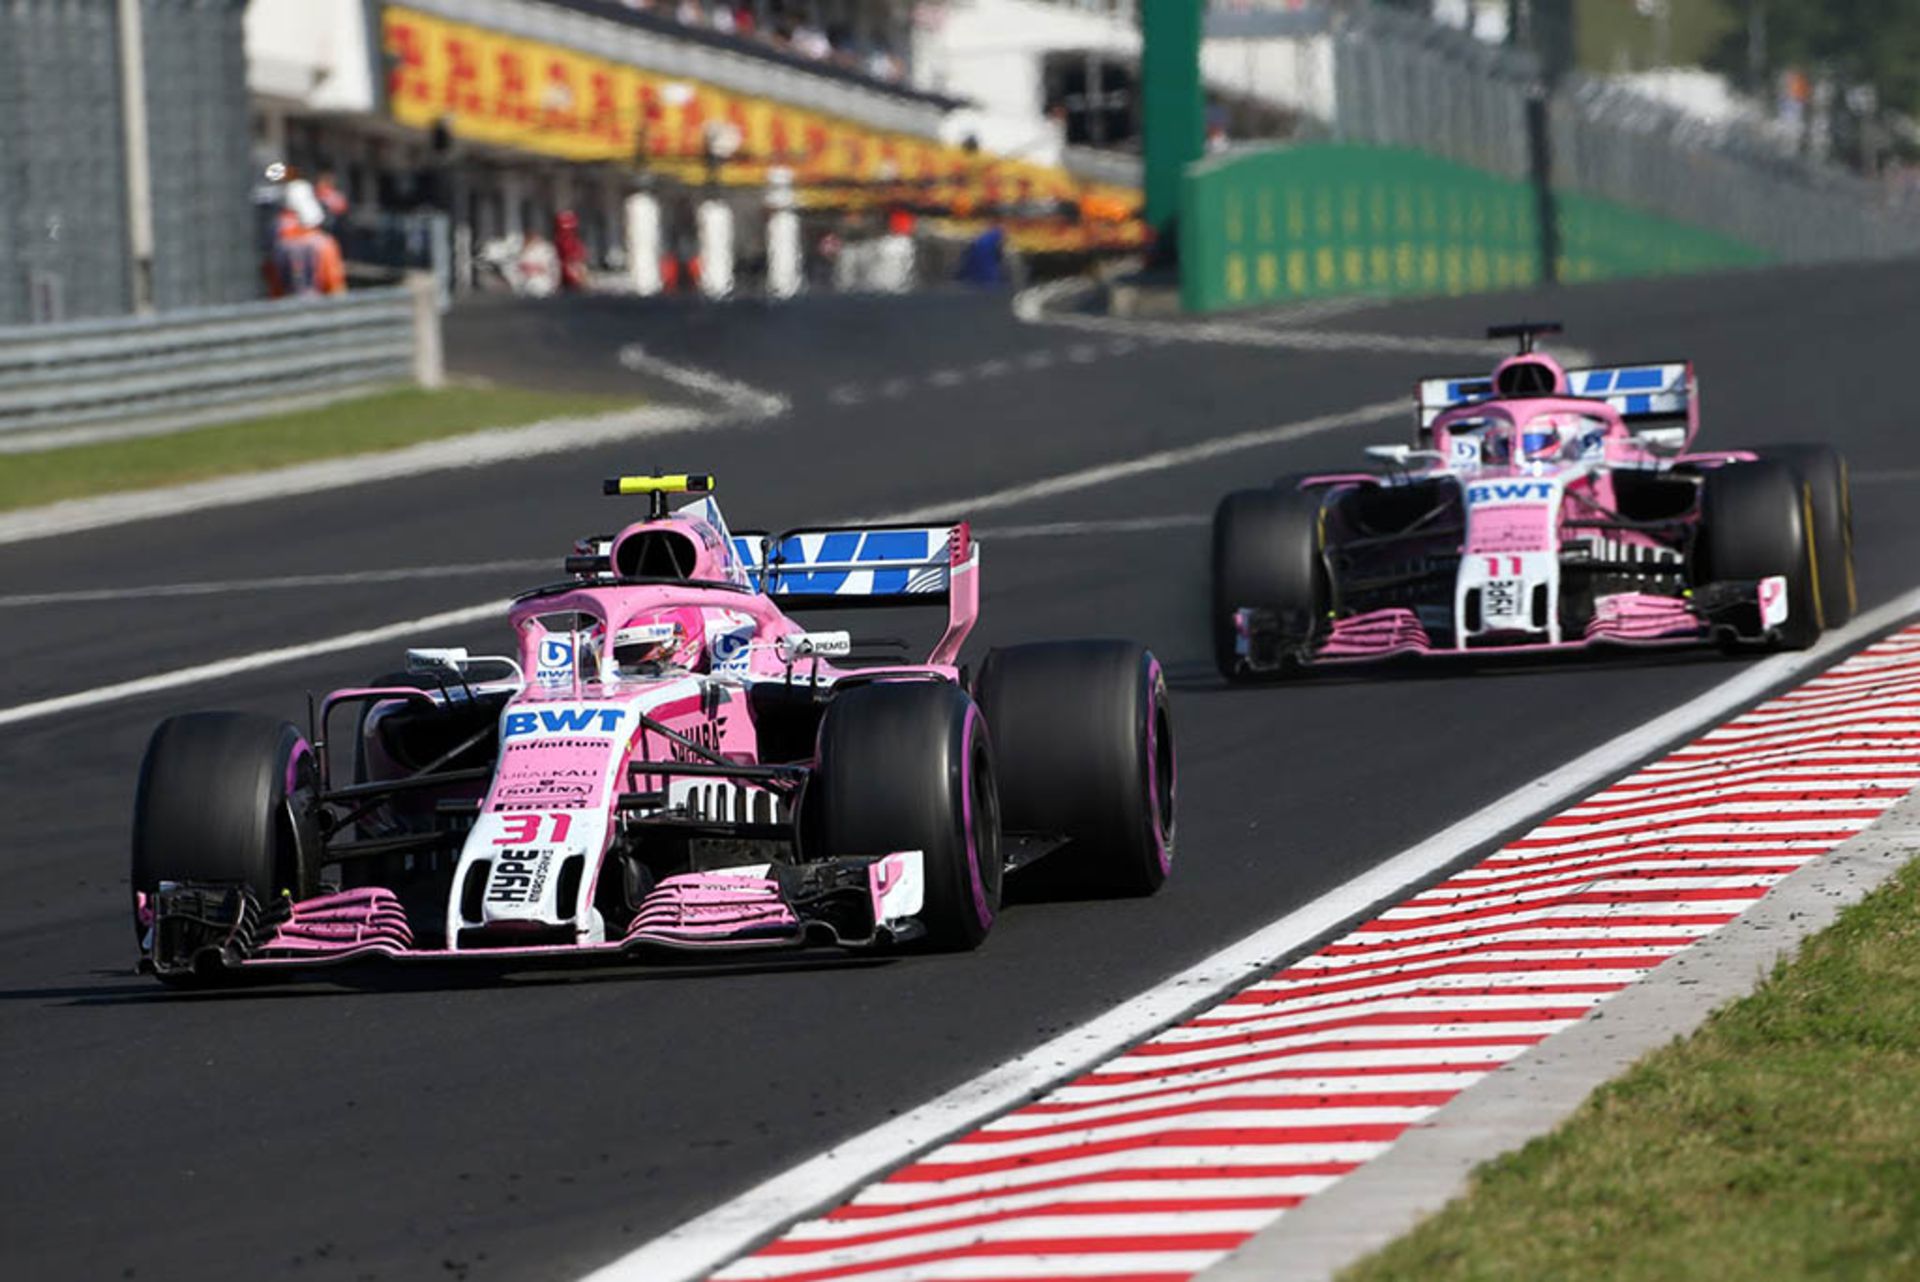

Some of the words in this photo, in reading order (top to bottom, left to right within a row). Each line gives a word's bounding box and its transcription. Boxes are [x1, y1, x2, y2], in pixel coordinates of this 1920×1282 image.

[1468, 483, 1553, 503] BWT
[1483, 556, 1522, 577] 11
[505, 708, 625, 737] BWT
[506, 738, 610, 752] infinitum
[492, 813, 572, 845] 31
[487, 849, 539, 902] HYPE
